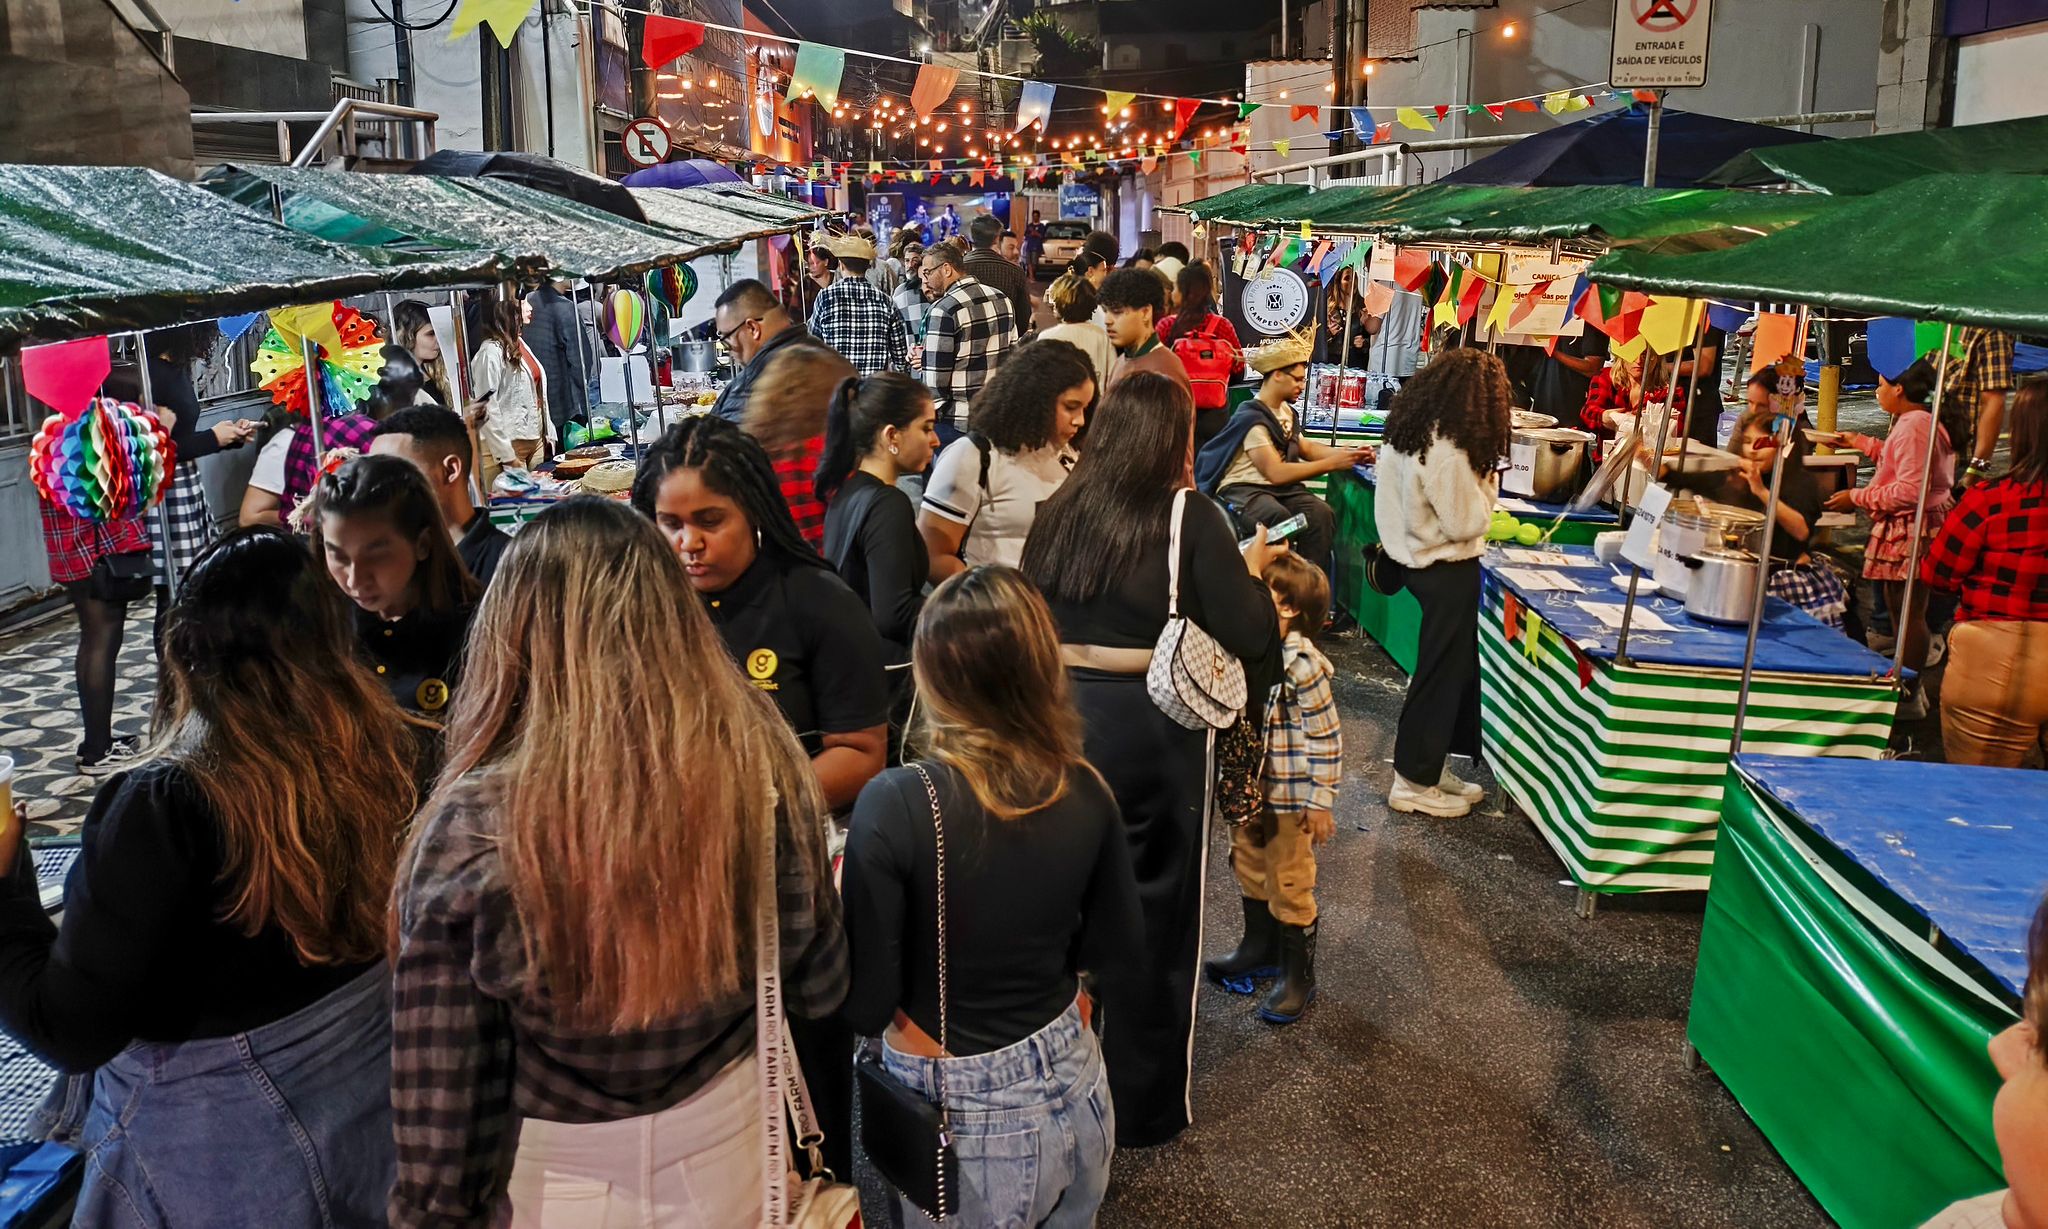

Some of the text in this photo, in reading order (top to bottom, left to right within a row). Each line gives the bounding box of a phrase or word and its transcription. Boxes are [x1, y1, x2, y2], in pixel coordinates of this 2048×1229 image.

[1635, 41, 1685, 51] ENTRADA E
[1616, 54, 1702, 66] SAÍDA DE VEÍCULOS
[764, 976, 776, 1018] FARM
[765, 1020, 778, 1043] RIO
[766, 1047, 778, 1088] FARM
[782, 1055, 794, 1076] RIO
[767, 1091, 779, 1113] RIO
[787, 1075, 805, 1112] FARM
[798, 1113, 812, 1134] RIO
[767, 1116, 779, 1156] FARM
